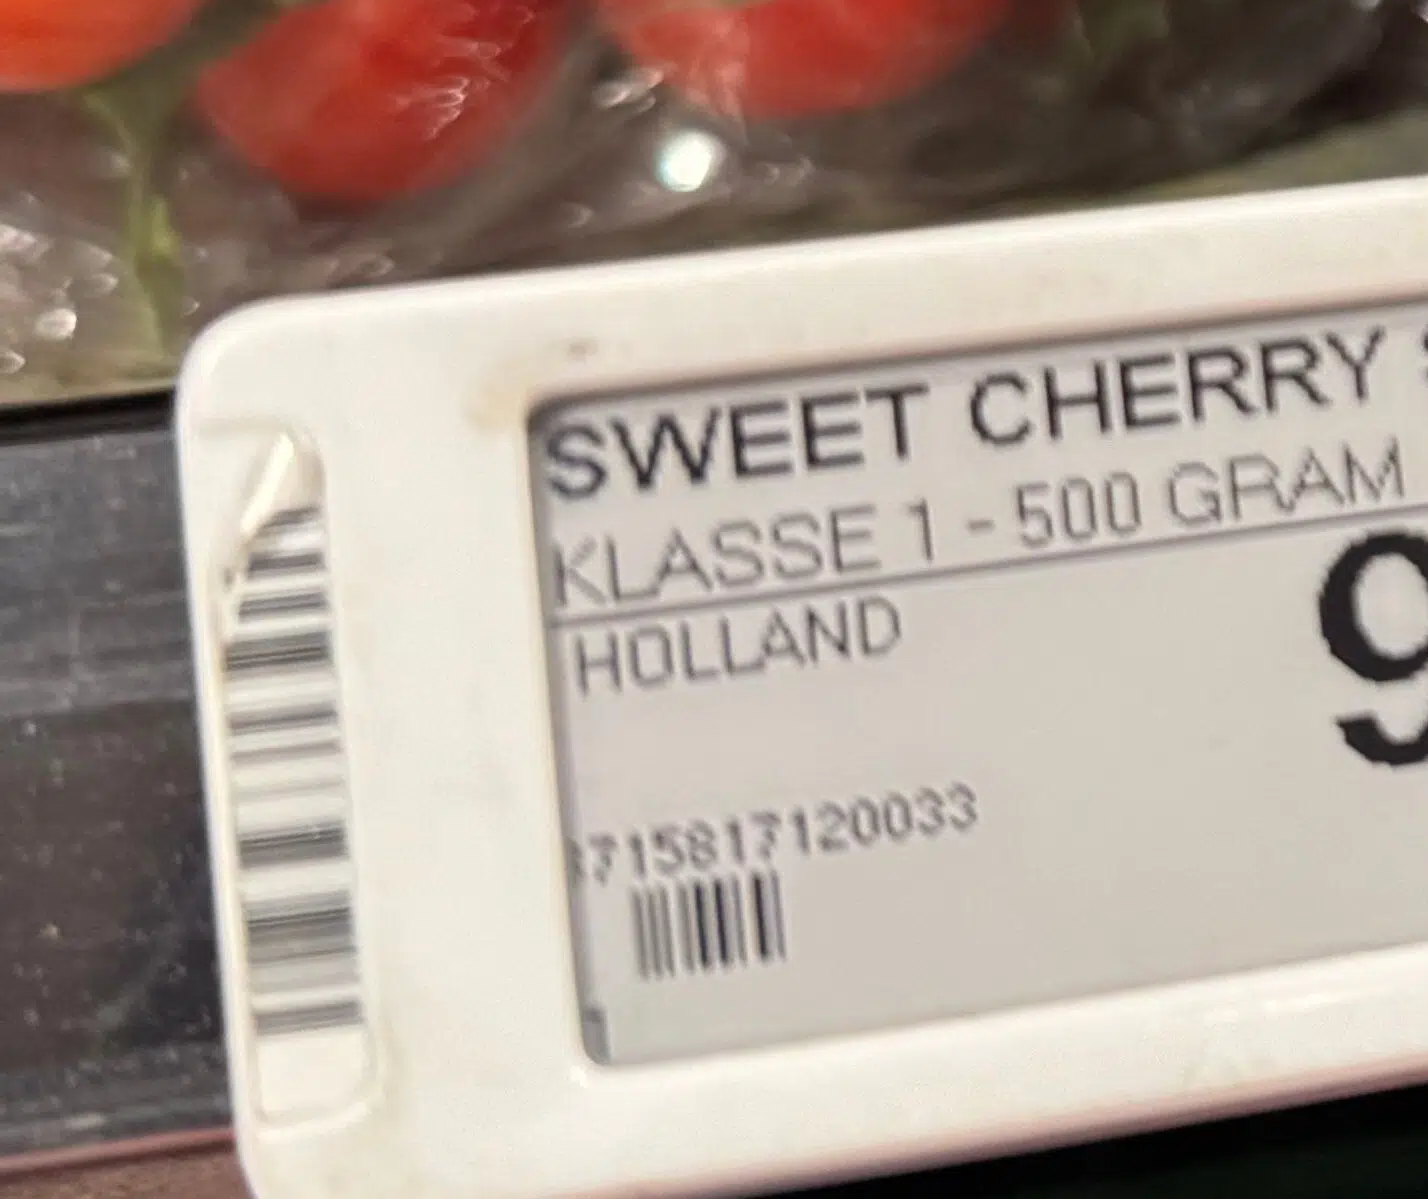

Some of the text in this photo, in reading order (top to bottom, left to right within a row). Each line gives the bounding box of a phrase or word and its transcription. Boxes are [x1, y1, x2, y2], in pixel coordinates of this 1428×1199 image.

[545, 383, 930, 500] SWEET
[968, 326, 1386, 446] CHERRY
[552, 504, 880, 608] KLASSE
[908, 498, 936, 562] 1
[1018, 470, 1142, 550] 500
[1166, 436, 1408, 530] GRAM
[573, 595, 903, 700] HOLLAND
